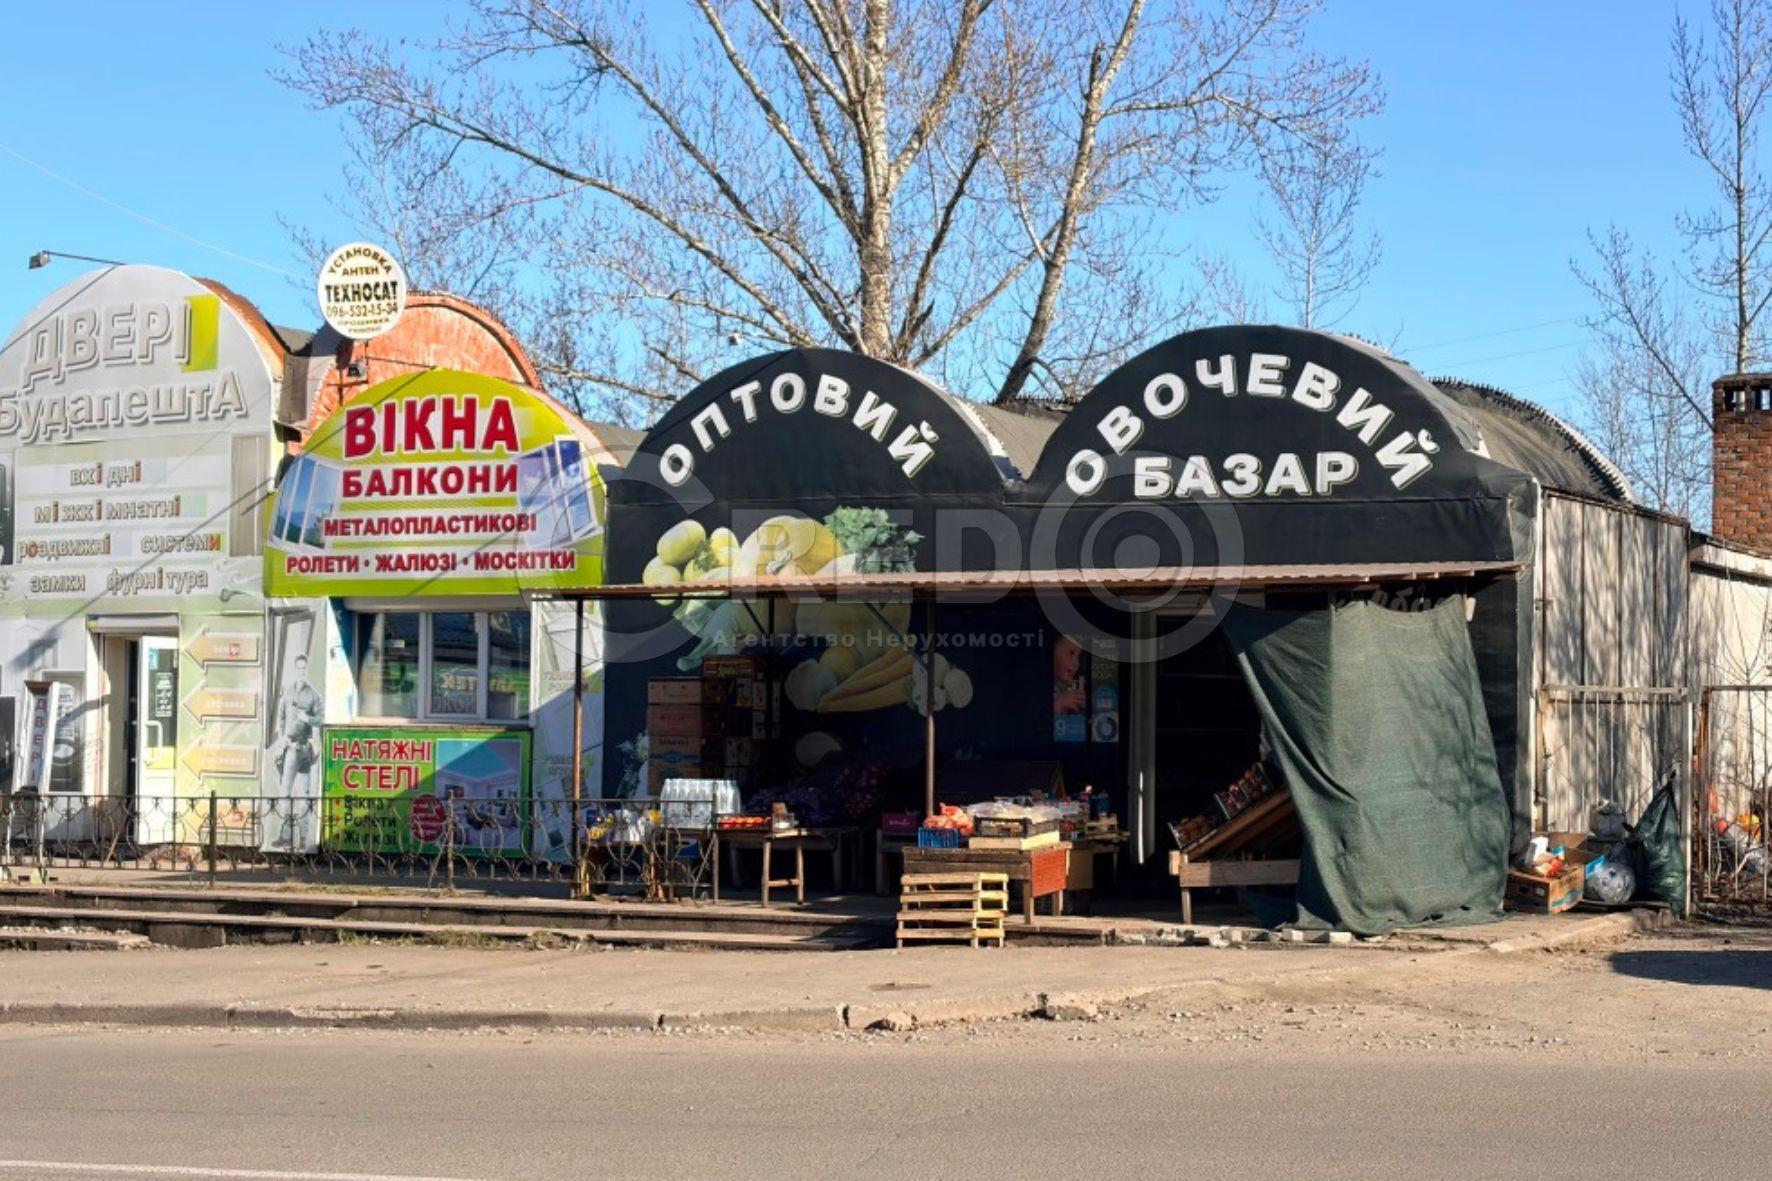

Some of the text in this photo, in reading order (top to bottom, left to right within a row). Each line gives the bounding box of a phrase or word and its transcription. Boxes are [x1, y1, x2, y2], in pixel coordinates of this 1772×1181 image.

[328, 246, 393, 276] УСТАНОВКА
[342, 266, 380, 277] АНТЕН
[324, 280, 398, 303] ТЕХНОСАТ
[22, 301, 192, 392] ДВЕРІ
[343, 396, 519, 458] ВІКНА
[659, 372, 939, 487] ОПТОВИЙ
[1065, 352, 1441, 497] ОВОЧЕВИЙ
[341, 464, 518, 498] БАЛКОНИ
[1134, 451, 1360, 499] БАЗАР
[323, 512, 537, 537] МЕТАЛОПЛАСТИКОВІ
[140, 533, 222, 554] системи
[286, 551, 576, 574] РОЛЕТИ ЖАЛЮЗІ МОСКІТКИ
[29, 566, 209, 595] замки фурнітура
[332, 738, 432, 762] НАТЯЖНІ
[342, 765, 420, 790] СТЕЛІ
